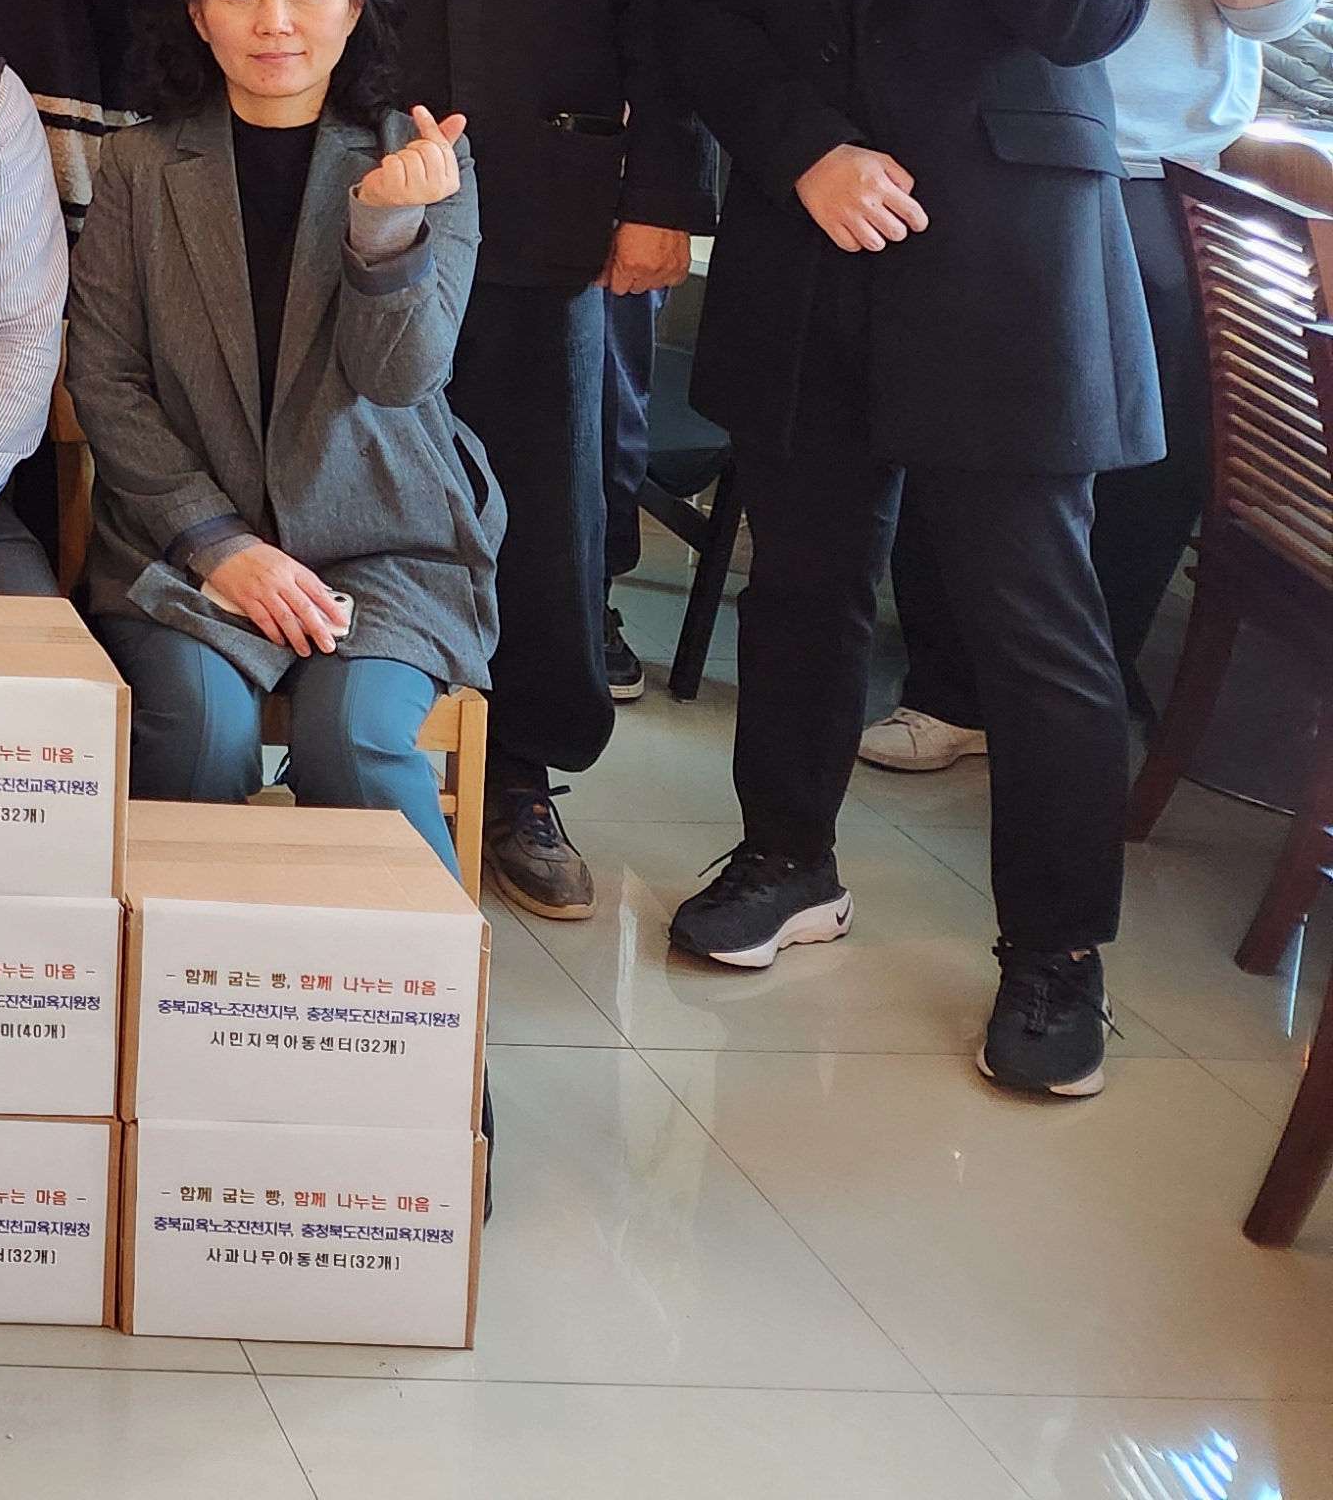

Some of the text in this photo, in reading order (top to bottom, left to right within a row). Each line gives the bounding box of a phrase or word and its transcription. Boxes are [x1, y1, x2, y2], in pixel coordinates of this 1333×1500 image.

[42, 746, 75, 764] 마음
[44, 963, 76, 980] 마음
[185, 968, 437, 997] 함께 굽는 빵, 함께 나누는 마음
[157, 999, 460, 1029] 충북교육노조진천지부, 충청북도진천교육지원청
[35, 1189, 68, 1207] 마음
[179, 1185, 430, 1213] 함께 굽는 빵, 함께 나누는 마음
[153, 1216, 454, 1244] 충북교육노조진천지부, 충청북도진천교육지원청
